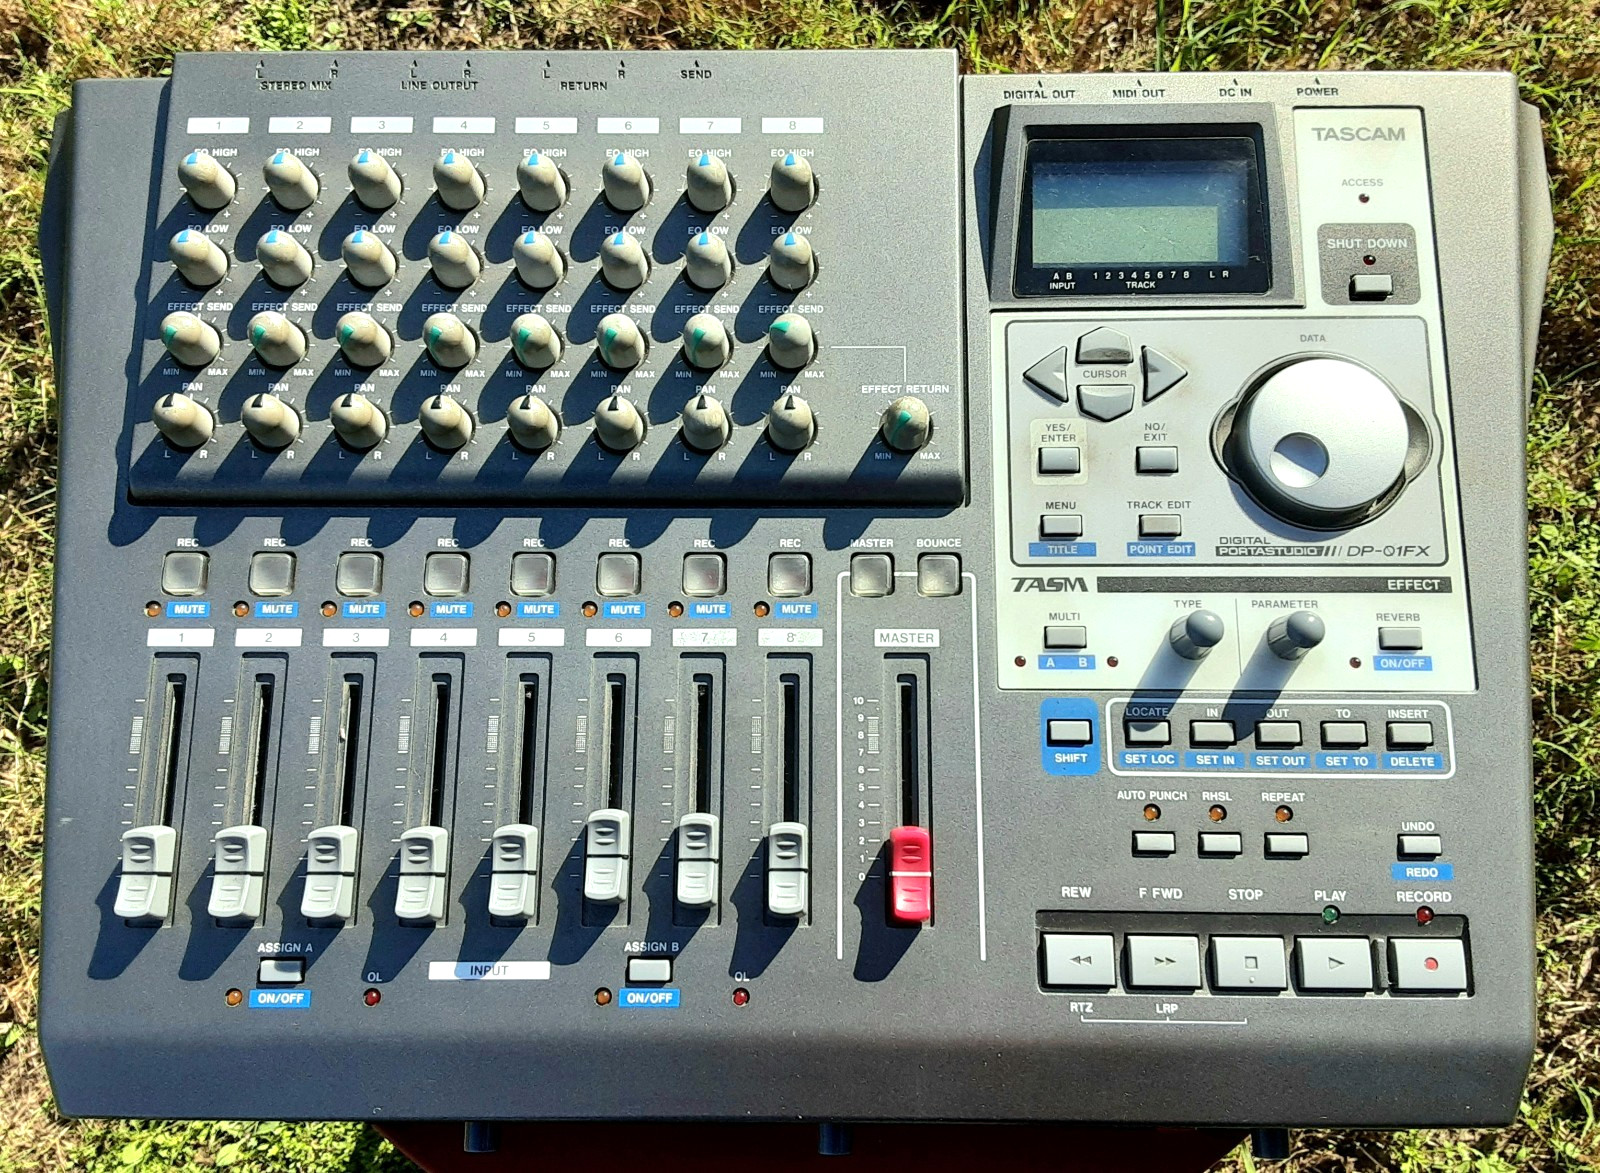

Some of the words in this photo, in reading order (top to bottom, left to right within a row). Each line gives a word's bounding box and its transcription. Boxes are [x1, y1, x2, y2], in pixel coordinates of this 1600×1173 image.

[681, 70, 712, 79] SEND
[259, 81, 306, 90] STEREO
[310, 81, 331, 90] MIX
[401, 81, 426, 90] LINE
[431, 81, 478, 90] OUTPUT
[560, 82, 608, 91] RETURN
[1003, 90, 1047, 100] DIGITAL
[1052, 90, 1075, 99] OUT
[1113, 89, 1138, 98] MIDI
[1142, 89, 1165, 98] OUT
[1219, 89, 1237, 97] DC
[1240, 89, 1251, 97] IN
[1296, 88, 1339, 96] POWER
[216, 121, 221, 130] 1
[296, 121, 303, 130] 2
[378, 121, 386, 130] 3
[460, 121, 468, 130] 4
[542, 121, 550, 130] 5
[624, 121, 632, 130] 6
[707, 121, 714, 130] 7
[789, 121, 796, 130] 8
[1311, 127, 1406, 141] TASCAM
[1341, 178, 1383, 187] ACCESS
[1327, 238, 1363, 249] SHUT
[1367, 238, 1408, 248] DOWN
[1053, 272, 1060, 280] A
[1066, 272, 1073, 280] B
[1050, 282, 1076, 290] INPUT
[1126, 281, 1156, 289] TRACK
[167, 303, 204, 311] EFFECT
[207, 303, 233, 311] SEND
[758, 305, 795, 314] EFFECT
[798, 305, 824, 314] SEND
[1300, 334, 1326, 343] DATA
[805, 370, 825, 378] MAX
[1083, 370, 1127, 378] CURSOR
[781, 385, 801, 394] PAN
[861, 385, 902, 393] EFFECT
[906, 385, 949, 393] RETURN
[1046, 423, 1071, 432] YES/
[1145, 423, 1166, 431] NO/
[1041, 434, 1076, 442] ENTER
[1144, 433, 1168, 441] EXIT
[804, 453, 812, 461] R
[875, 452, 892, 460] MIN
[920, 452, 940, 460] MAX
[1045, 501, 1076, 510] MENU
[1127, 501, 1162, 509] TRACK
[1168, 501, 1192, 509] EDIT
[177, 538, 199, 547] REC
[264, 538, 286, 547] REC
[350, 538, 373, 547] REC
[437, 538, 459, 547] REC
[523, 538, 545, 547] REC
[609, 538, 631, 547] REC
[694, 539, 715, 548] REC
[780, 538, 801, 548] REC
[850, 539, 894, 547] MASTER
[916, 539, 962, 547] BOUNCE
[1219, 536, 1271, 545] DIGITAL
[1047, 545, 1078, 554] TITLE
[1130, 545, 1164, 554] POINT
[1168, 545, 1192, 554] EDIT
[1219, 547, 1318, 556] PORTASTUDIO
[1347, 545, 1430, 557] DP-01FX
[1011, 577, 1088, 592] TASM
[1387, 580, 1440, 590] EFFECT
[1174, 600, 1202, 608] TYPE
[1251, 600, 1318, 609] PARAMETER
[174, 605, 205, 614] MUTE
[262, 605, 293, 614] MUTE
[349, 605, 380, 614] MUTE
[436, 605, 467, 614] MUTE
[523, 605, 555, 615] MUTE
[610, 605, 641, 615] MUTE
[696, 604, 726, 614] MUTE
[781, 604, 812, 614] MUTE
[1049, 612, 1080, 621] MULTI
[1376, 613, 1420, 621] REVERB
[179, 632, 184, 642] 1
[265, 632, 272, 642] 2
[352, 632, 360, 642] 3
[440, 632, 448, 642] 4
[528, 632, 535, 642] 5
[615, 632, 622, 642] 6
[701, 632, 708, 642] 7
[786, 632, 794, 642] 8
[879, 633, 934, 643] MASTER
[1046, 658, 1055, 667] A
[1079, 658, 1087, 667] B
[1380, 659, 1425, 668] ON/OFF
[853, 697, 864, 705] 10
[1126, 707, 1169, 717] LOCATE
[1207, 708, 1218, 717] IN
[1266, 709, 1289, 718] OUT
[1336, 709, 1351, 718] TO
[1388, 709, 1428, 718] INSERT
[857, 714, 864, 722] 9
[857, 731, 864, 739] 8
[1055, 754, 1088, 763] SHIFT
[1125, 754, 1147, 763] SET
[1152, 755, 1175, 764] LOC
[1196, 755, 1219, 764] SET
[1223, 756, 1235, 764] IN
[1256, 756, 1278, 765] SET
[1282, 756, 1306, 765] OUT
[1326, 756, 1348, 766] SET
[1353, 757, 1368, 766] TO
[1390, 757, 1435, 766] DELETE
[857, 766, 864, 774] 6
[858, 783, 864, 791] 5
[1117, 790, 1146, 800] AUTO
[1150, 791, 1188, 800] PUNCH
[1202, 791, 1232, 801] RHSL
[1261, 792, 1305, 802] REPEAT
[857, 801, 864, 809] 4
[858, 819, 864, 827] 3
[1402, 822, 1435, 831] UNDO
[858, 836, 865, 845] 2
[859, 855, 864, 863] 1
[858, 872, 865, 881] 0
[1406, 868, 1438, 877] REDO
[1062, 886, 1092, 898] REW
[1139, 888, 1147, 898] F
[1153, 888, 1183, 899] FWD
[1228, 889, 1263, 900] STOP
[1314, 890, 1347, 901] PLAY
[1397, 891, 1452, 902] RECORD
[257, 942, 301, 953] ASSIGN
[305, 943, 313, 953] A
[624, 942, 667, 952] ASSIGN
[672, 942, 679, 951] B
[470, 966, 509, 976] INPUT
[367, 972, 382, 982] OL
[735, 972, 749, 982] OL
[257, 993, 304, 1004] ON/OFF
[627, 993, 673, 1003] ON/OFF
[1070, 1002, 1093, 1012] RTZ
[1156, 1004, 1178, 1014] LRP
